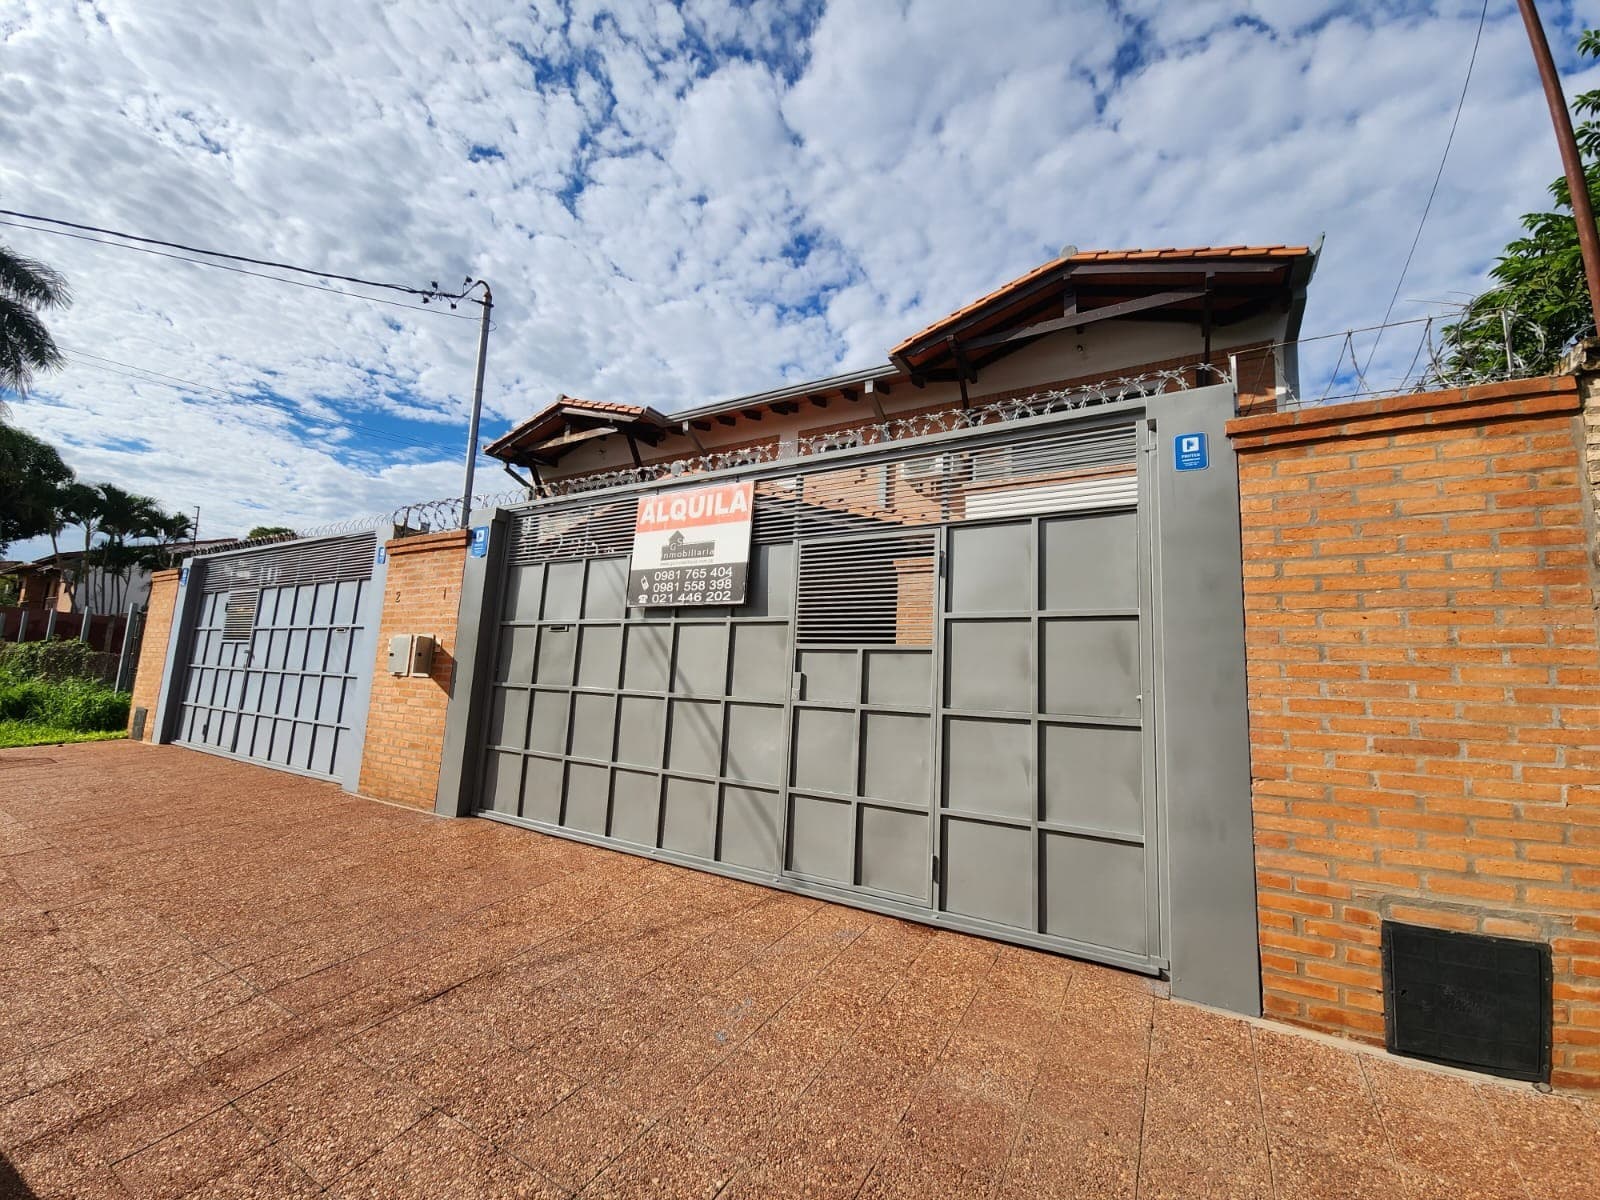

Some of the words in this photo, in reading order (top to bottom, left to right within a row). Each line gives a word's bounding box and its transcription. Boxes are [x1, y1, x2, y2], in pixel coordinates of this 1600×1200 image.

[640, 489, 747, 524] ALQUILA
[654, 570, 681, 581] 0981
[685, 568, 707, 579] 765
[710, 566, 732, 577] 404
[653, 582, 680, 593] 0981
[683, 580, 706, 592] 558
[709, 578, 732, 590] 398
[651, 593, 673, 604] 021
[678, 592, 702, 602] 446
[706, 590, 731, 602] 202
